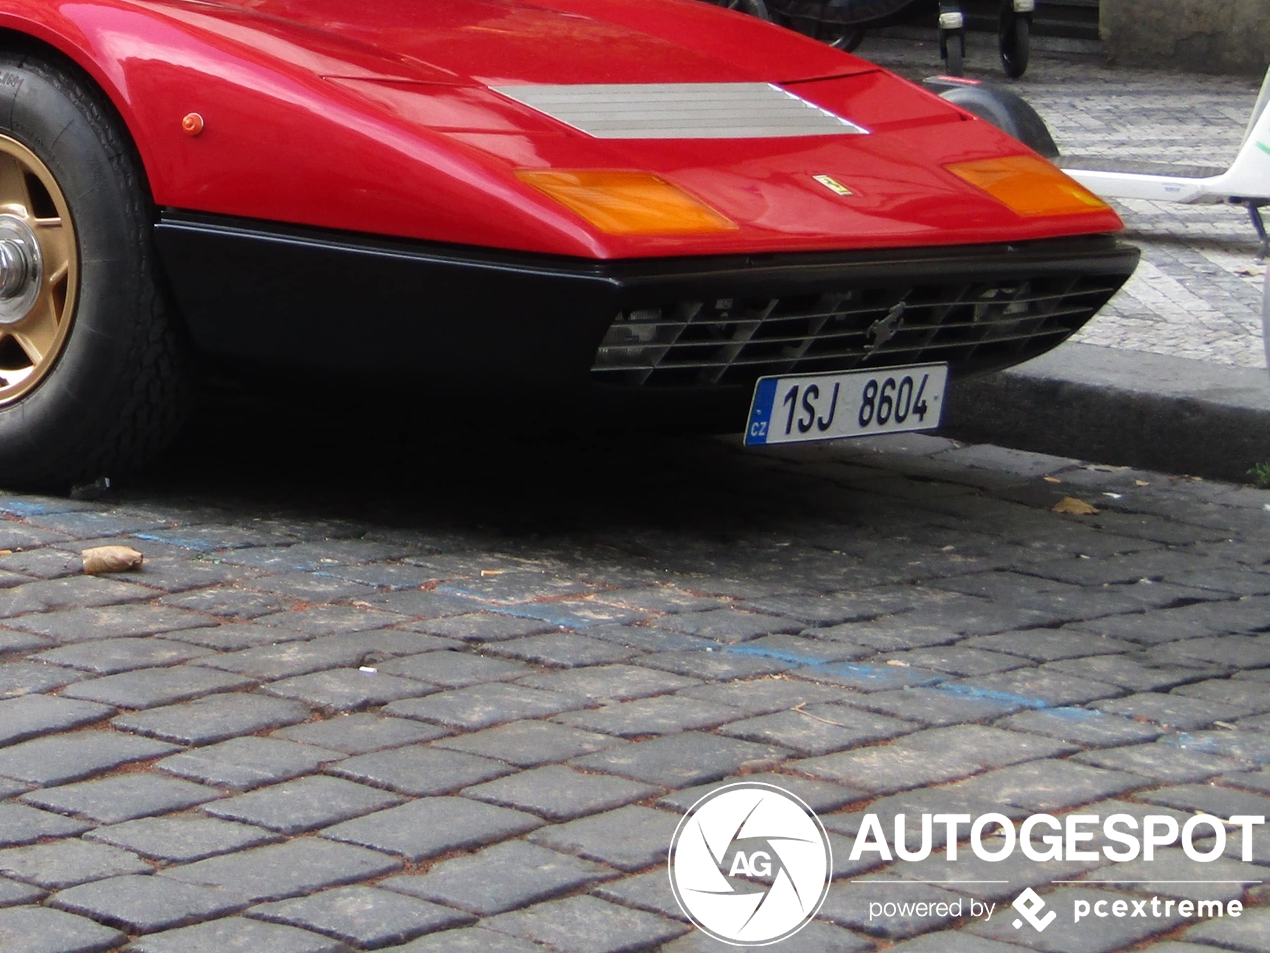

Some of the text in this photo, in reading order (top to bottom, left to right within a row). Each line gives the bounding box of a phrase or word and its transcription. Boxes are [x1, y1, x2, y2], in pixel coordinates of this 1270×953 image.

[783, 374, 929, 436] 1SJ 8604
[750, 422, 766, 436] CZ
